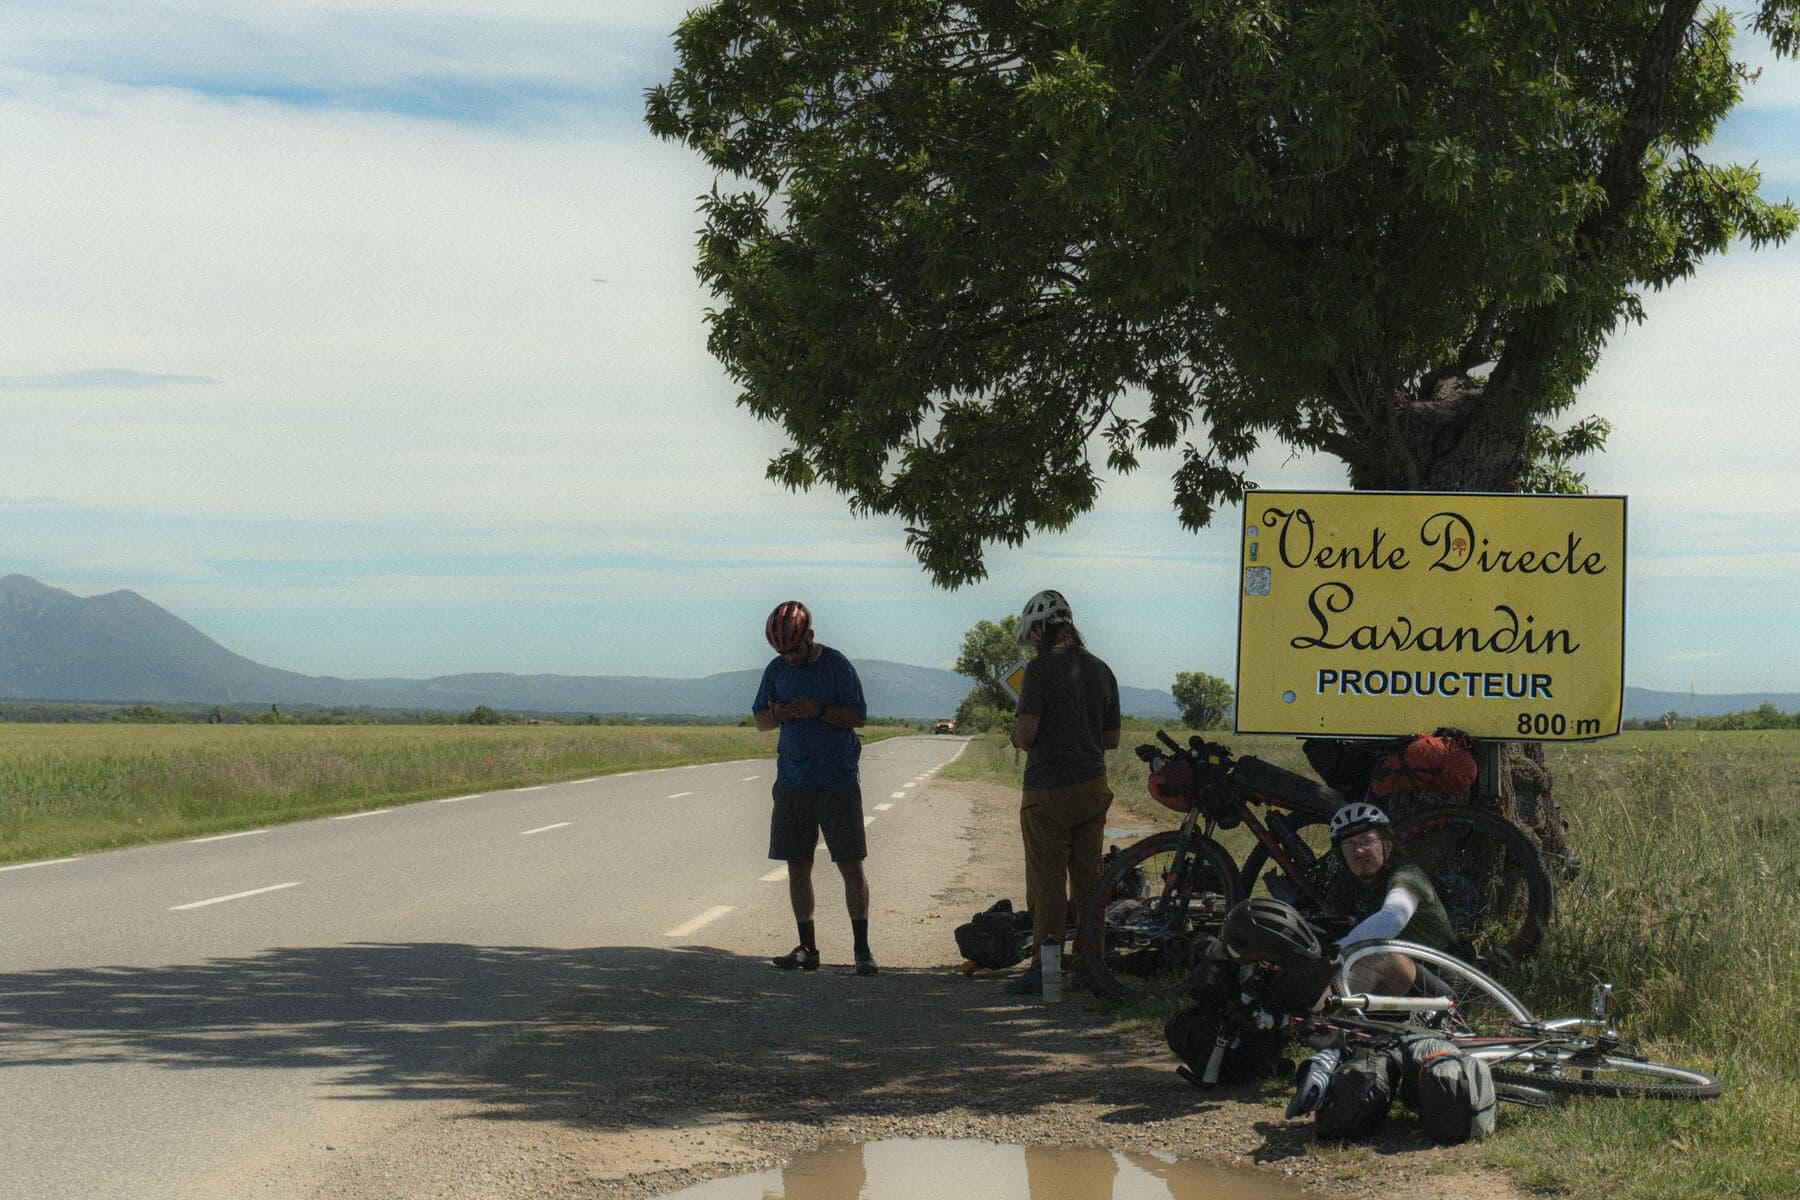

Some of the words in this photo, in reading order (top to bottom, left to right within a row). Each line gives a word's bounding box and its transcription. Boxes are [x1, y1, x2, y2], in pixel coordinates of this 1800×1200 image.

[1262, 507, 1410, 569] Vente
[1420, 512, 1607, 575] Directe
[1290, 581, 1580, 655] Lavandin
[1317, 669, 1553, 699] PRODUCTEUR
[1517, 713, 1566, 735] 800
